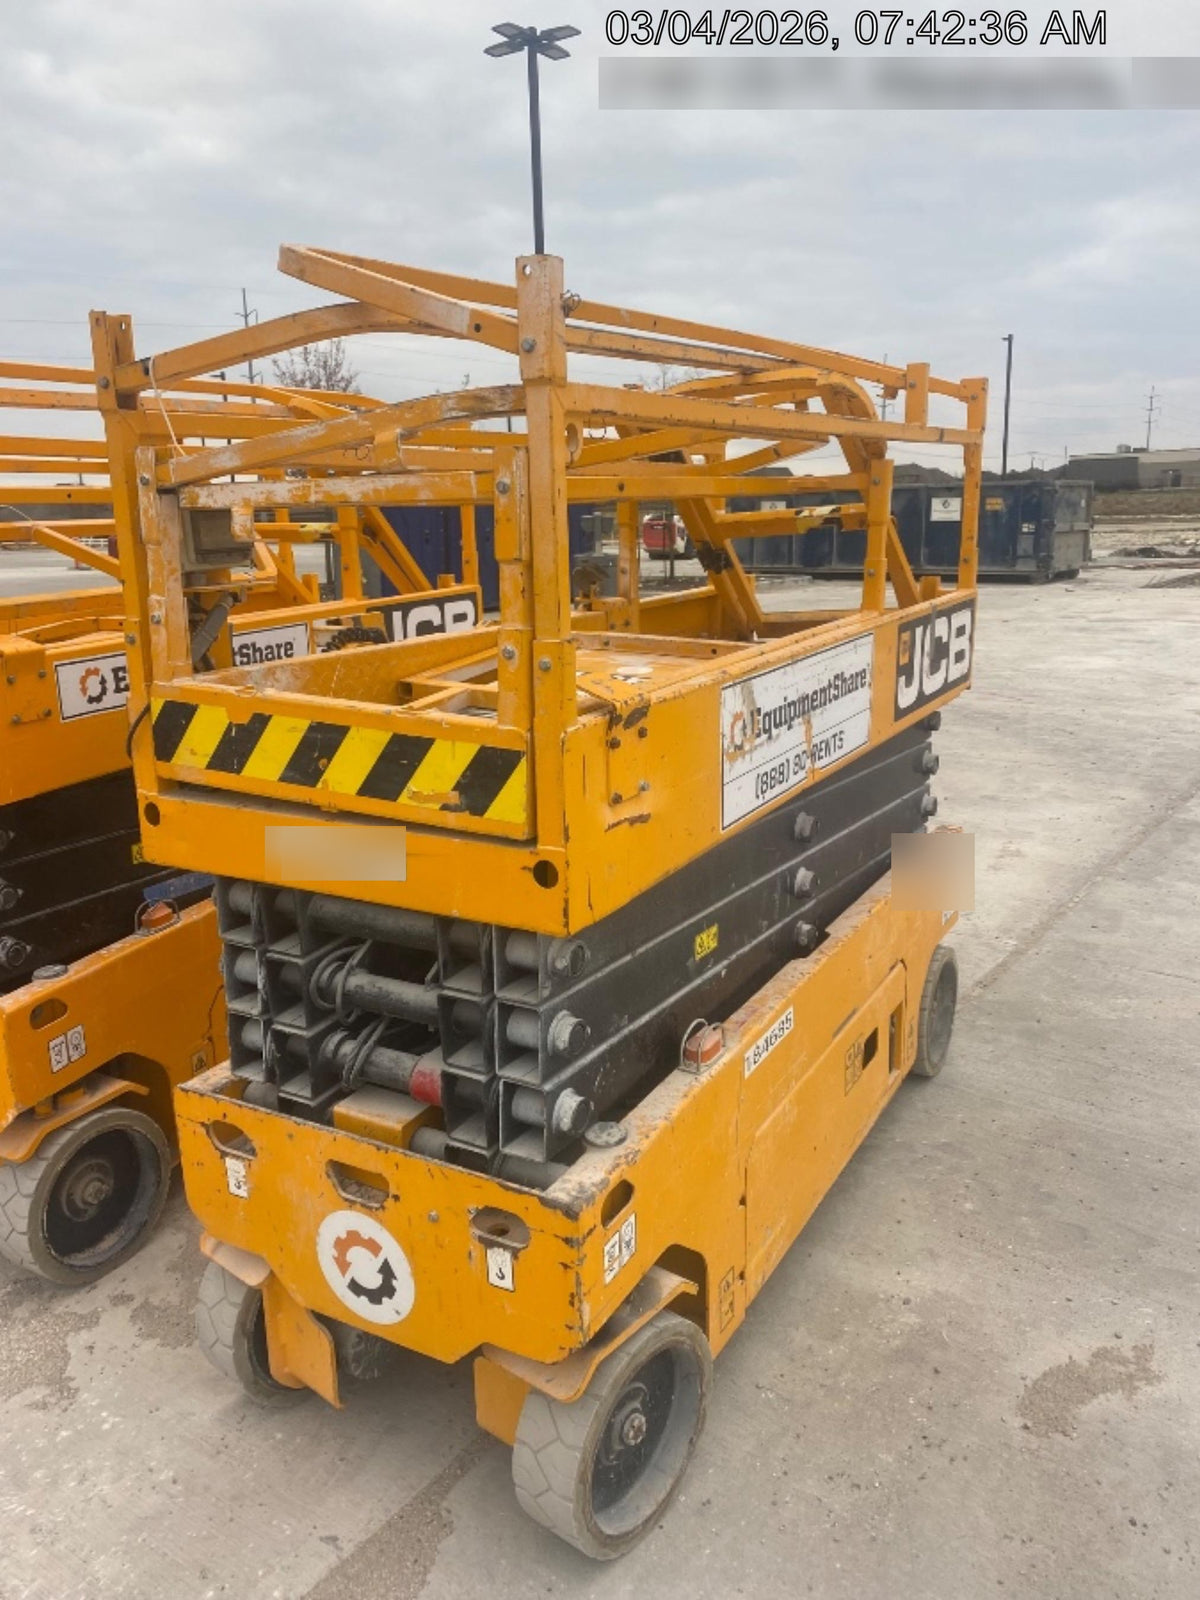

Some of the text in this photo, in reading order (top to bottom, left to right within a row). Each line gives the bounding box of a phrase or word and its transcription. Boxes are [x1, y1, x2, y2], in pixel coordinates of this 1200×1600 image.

[897, 608, 972, 710] JCB
[750, 667, 868, 740] EquipmentShare
[755, 758, 790, 799] (888)
